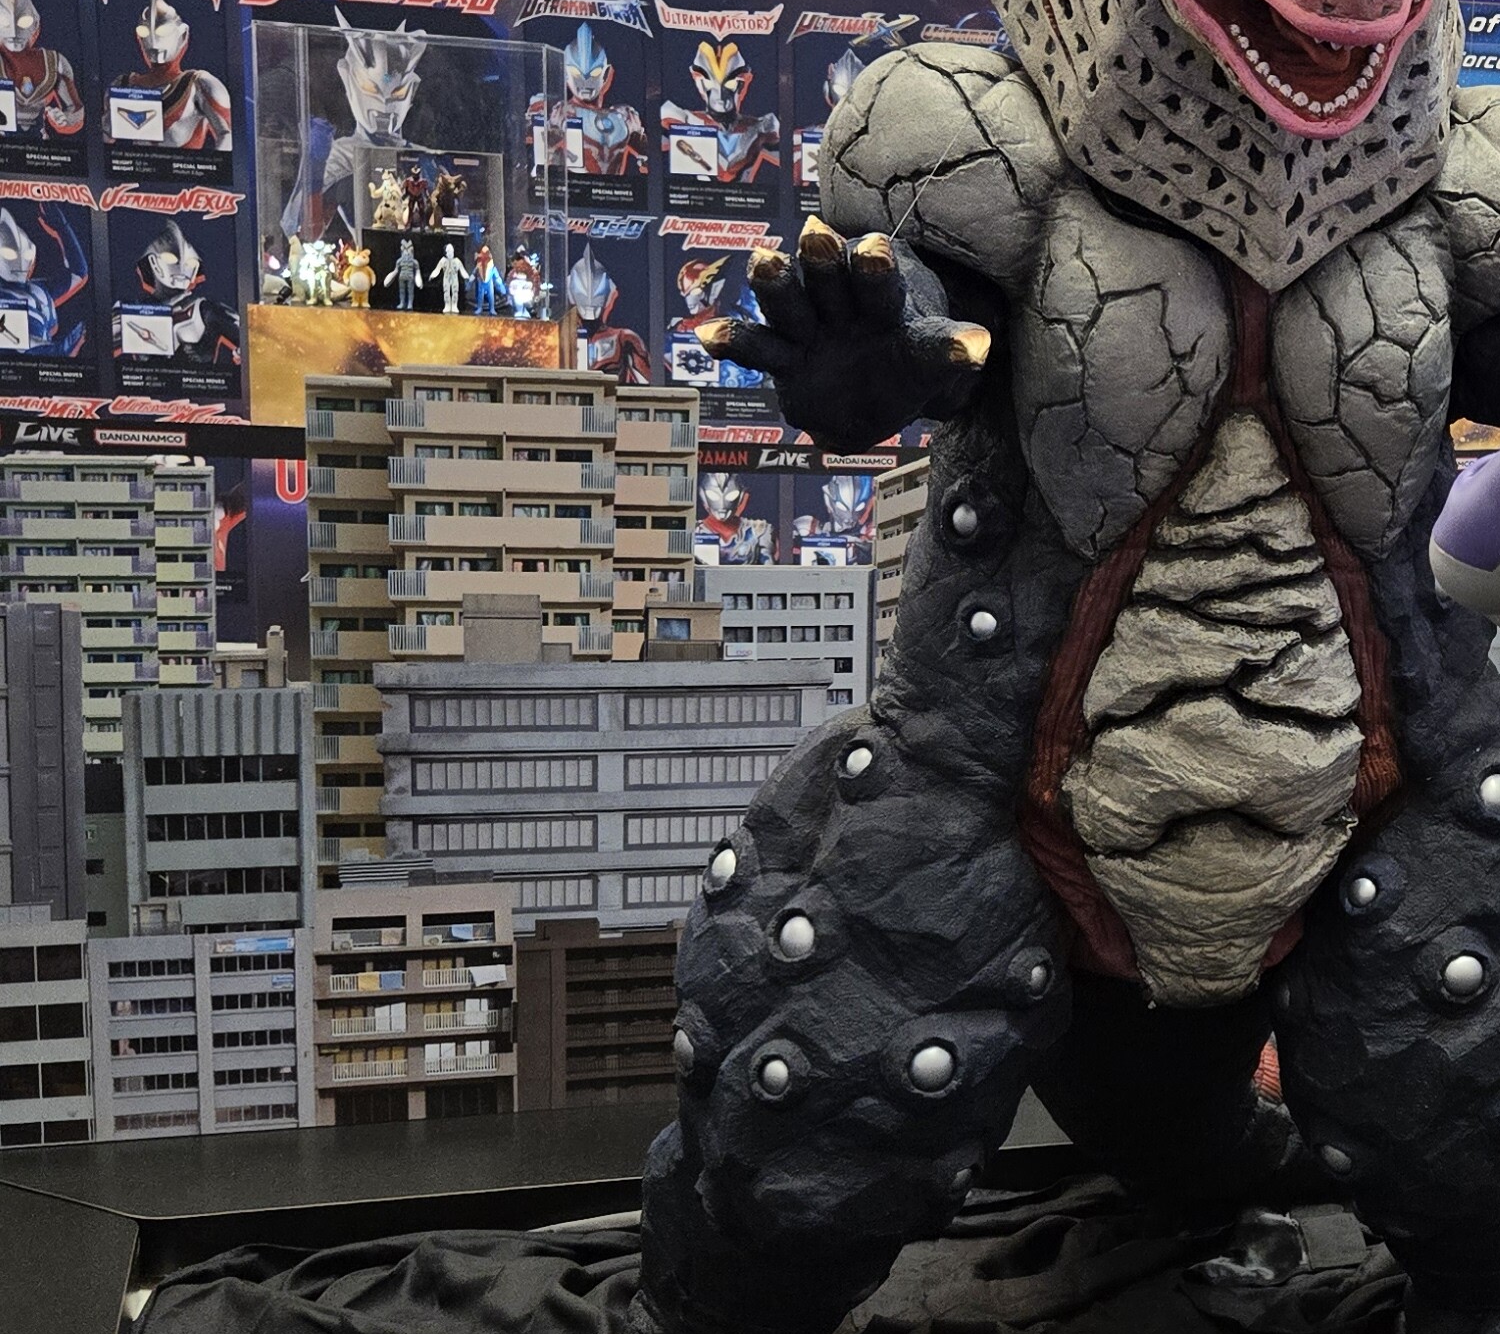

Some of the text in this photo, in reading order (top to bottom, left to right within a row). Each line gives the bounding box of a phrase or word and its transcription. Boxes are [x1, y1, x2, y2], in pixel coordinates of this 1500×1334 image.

[100, 432, 183, 443] BANDAI NAMCO
[826, 456, 894, 466] BANDAI NAMCO
